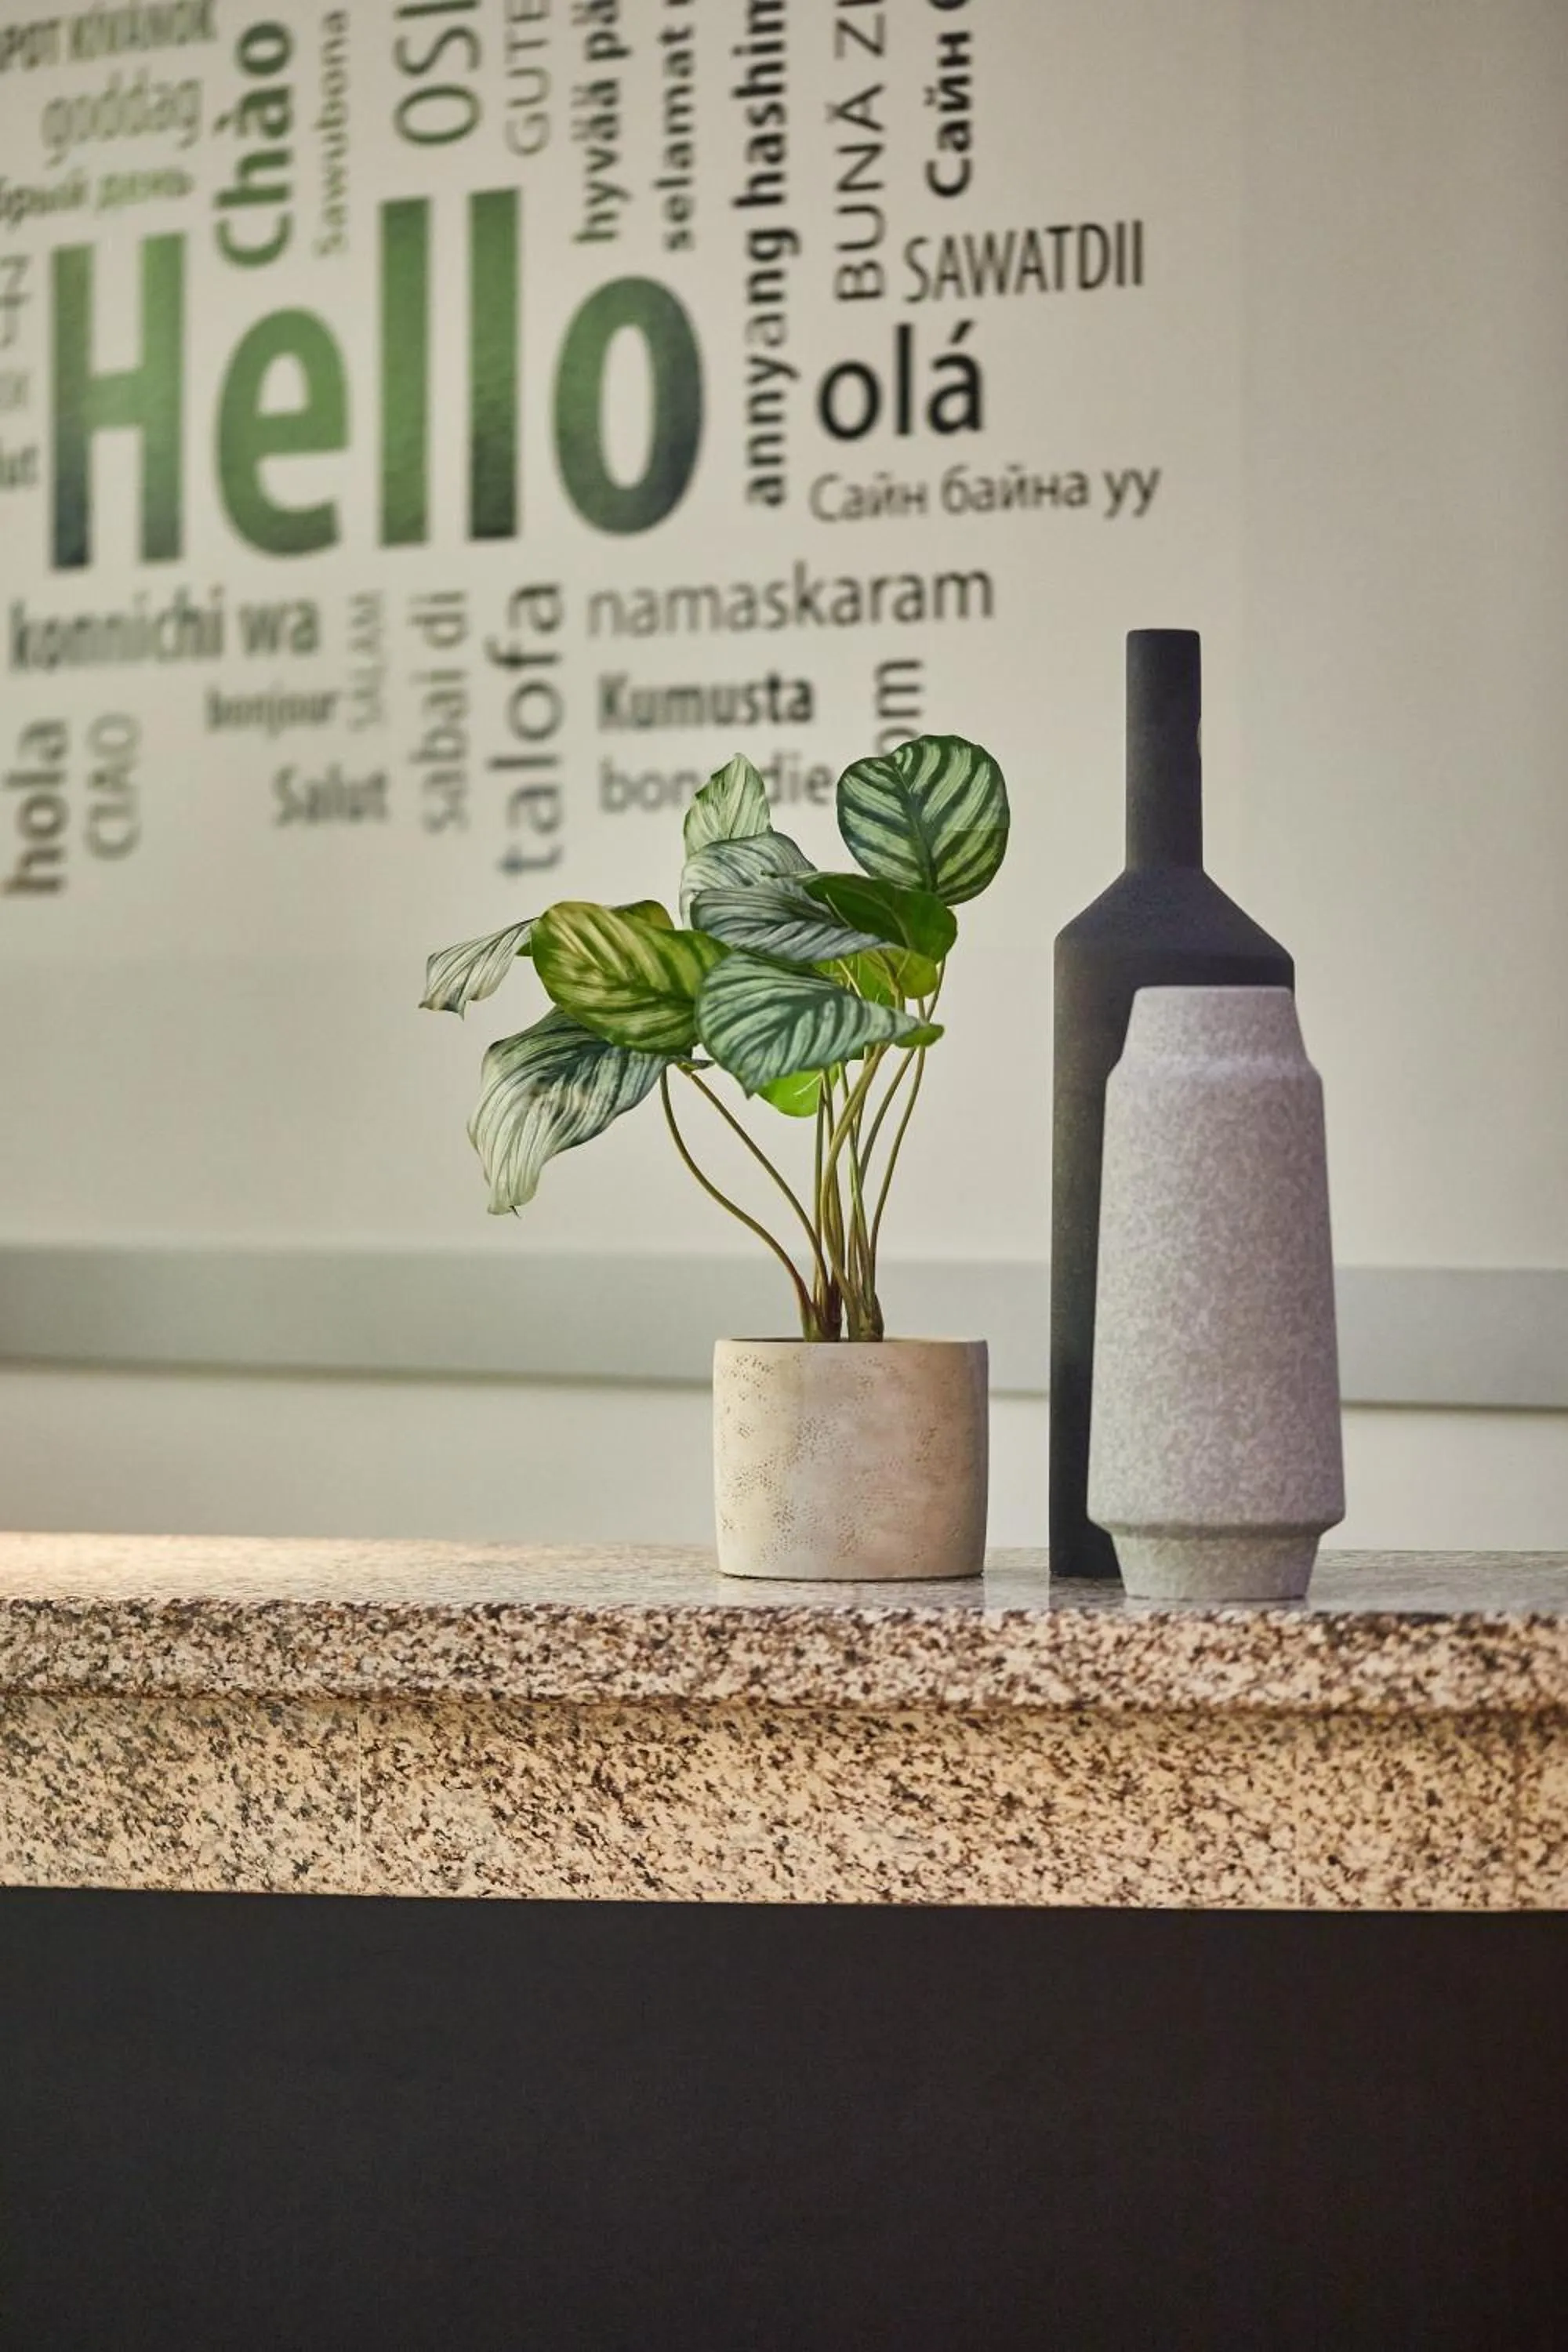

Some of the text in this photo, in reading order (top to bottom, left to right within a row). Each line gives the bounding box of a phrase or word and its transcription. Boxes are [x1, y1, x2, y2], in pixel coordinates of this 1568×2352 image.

[42, 64, 203, 168] goddag
[212, 20, 292, 268] Chào
[314, 9, 349, 257] Sawubona
[570, 78, 633, 244] hyvää
[651, 24, 695, 252] selamat
[924, 31, 972, 199] Сайн
[902, 220, 1144, 304] SAWATDII
[51, 187, 703, 572] Hello
[744, 227, 801, 510] annyang
[817, 318, 984, 443] olá
[808, 471, 929, 524] Сайн
[941, 463, 1090, 516] байна
[10, 584, 318, 676] konnichi wa
[586, 560, 995, 637] namaskaram
[407, 591, 469, 834] sabai di
[484, 584, 564, 878] talofa
[597, 670, 814, 733] Kumusta
[2, 718, 69, 898] hola
